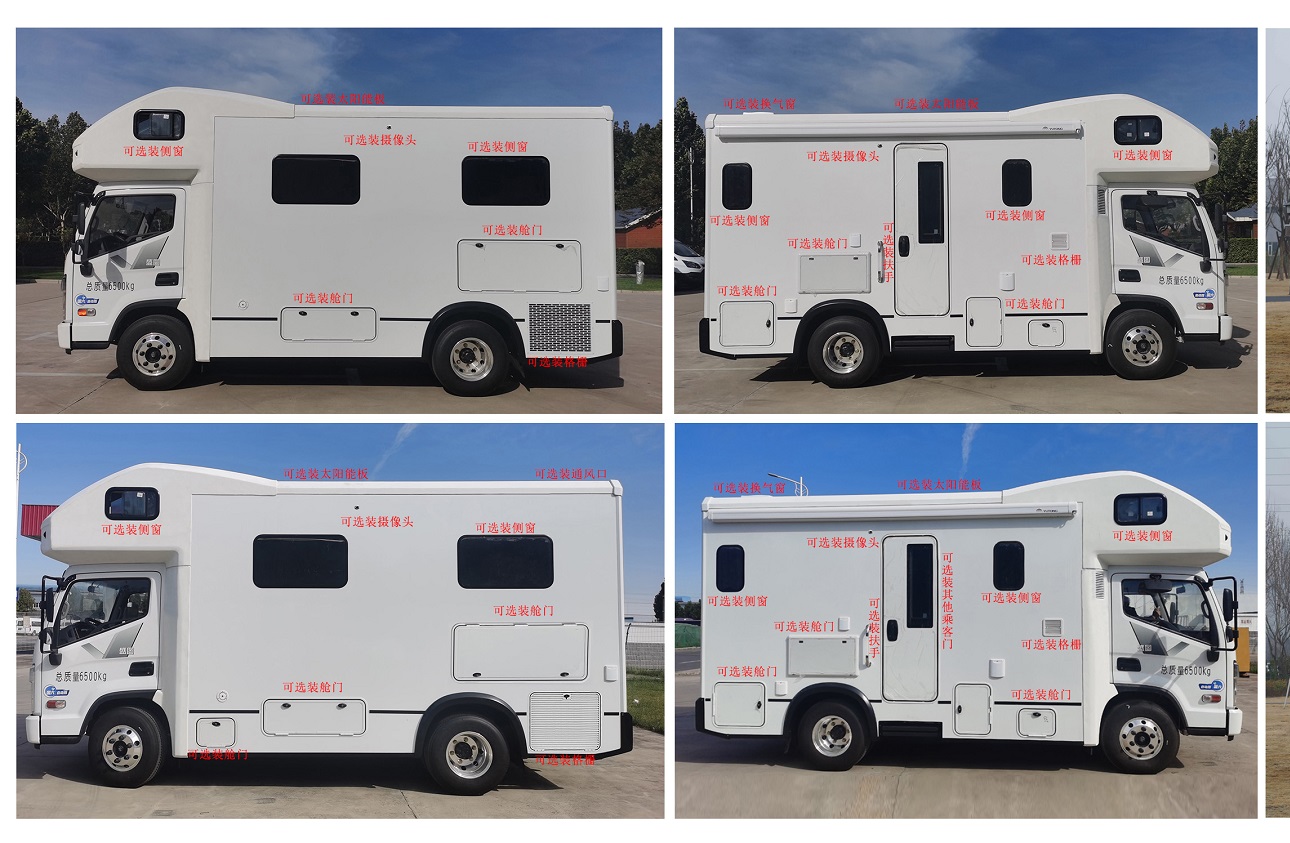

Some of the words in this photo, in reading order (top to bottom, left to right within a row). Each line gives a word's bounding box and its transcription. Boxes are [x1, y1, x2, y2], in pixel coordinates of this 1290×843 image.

[1158, 275, 1204, 286] 总质量6500kg
[86, 281, 135, 292] 总质量6500kg
[1160, 664, 1211, 677] 总质量6500kg
[55, 671, 107, 682] 总质量6500kg
